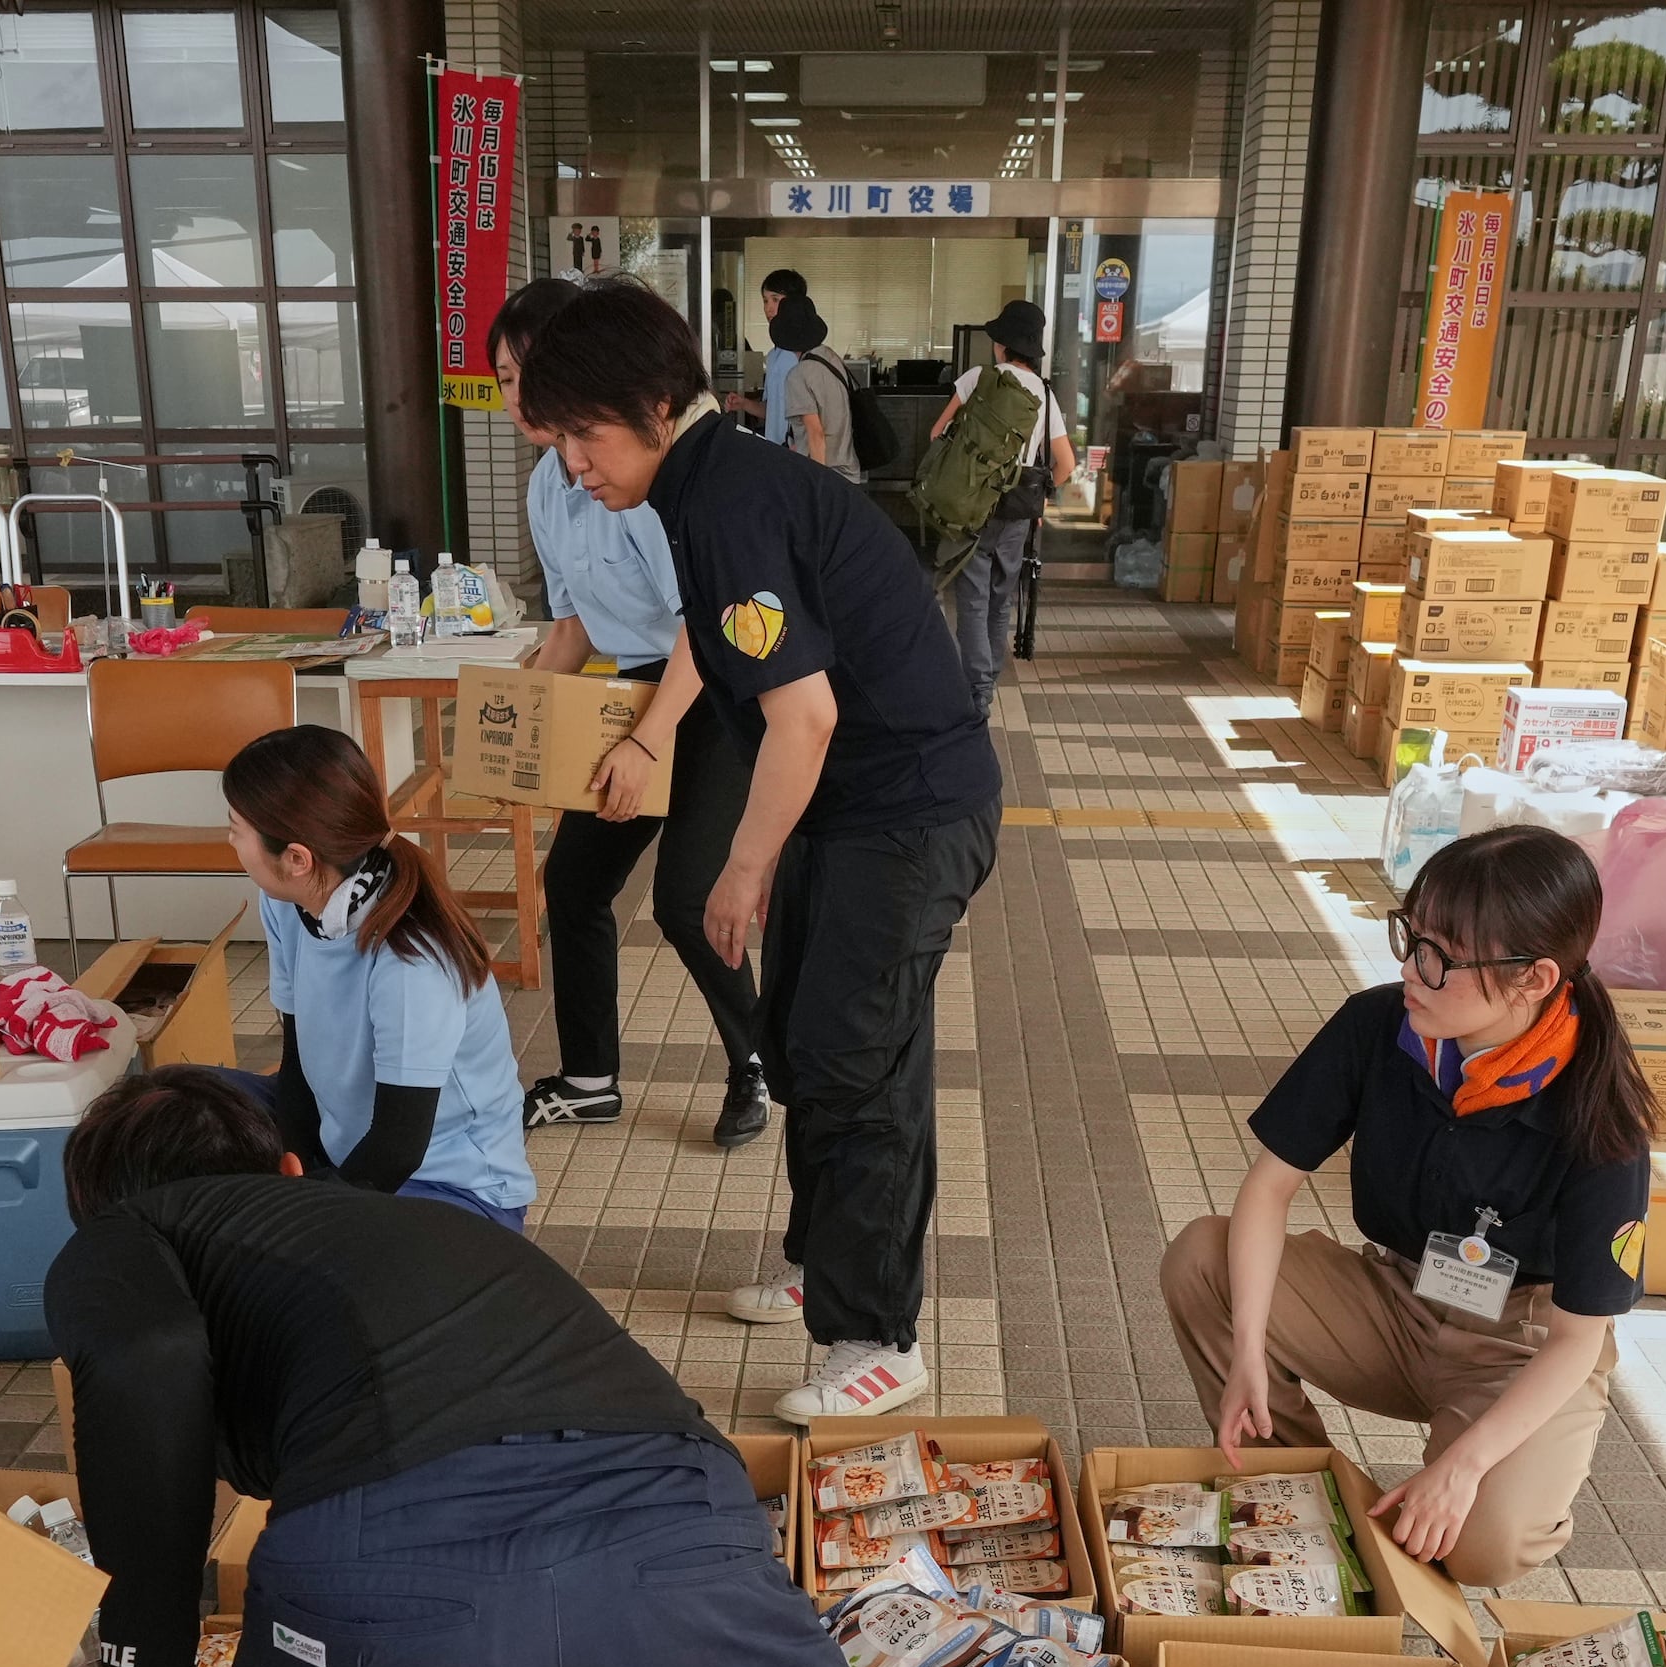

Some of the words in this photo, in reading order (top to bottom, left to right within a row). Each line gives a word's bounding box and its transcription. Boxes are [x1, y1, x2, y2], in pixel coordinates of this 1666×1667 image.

[476, 98, 503, 230] 毎月15日は
[788, 185, 973, 214] 氷川町役場
[446, 93, 476, 368] 氷川町交通安全の日
[1470, 213, 1501, 329] 毎月15日は
[1102, 303, 1118, 312] AED
[1425, 211, 1475, 428] 氷川町交通安全の
[443, 382, 493, 402] 氷川町
[1320, 489, 1351, 501] 白がゆ
[1642, 492, 1659, 501] 301
[1632, 554, 1648, 562] 301
[1313, 577, 1343, 588] 白がゆ
[1614, 613, 1628, 622] 301
[1604, 673, 1622, 681] 301
[1286, 1568, 1312, 1611] 山菜おこわ
[294, 1639, 324, 1655] CARBON
